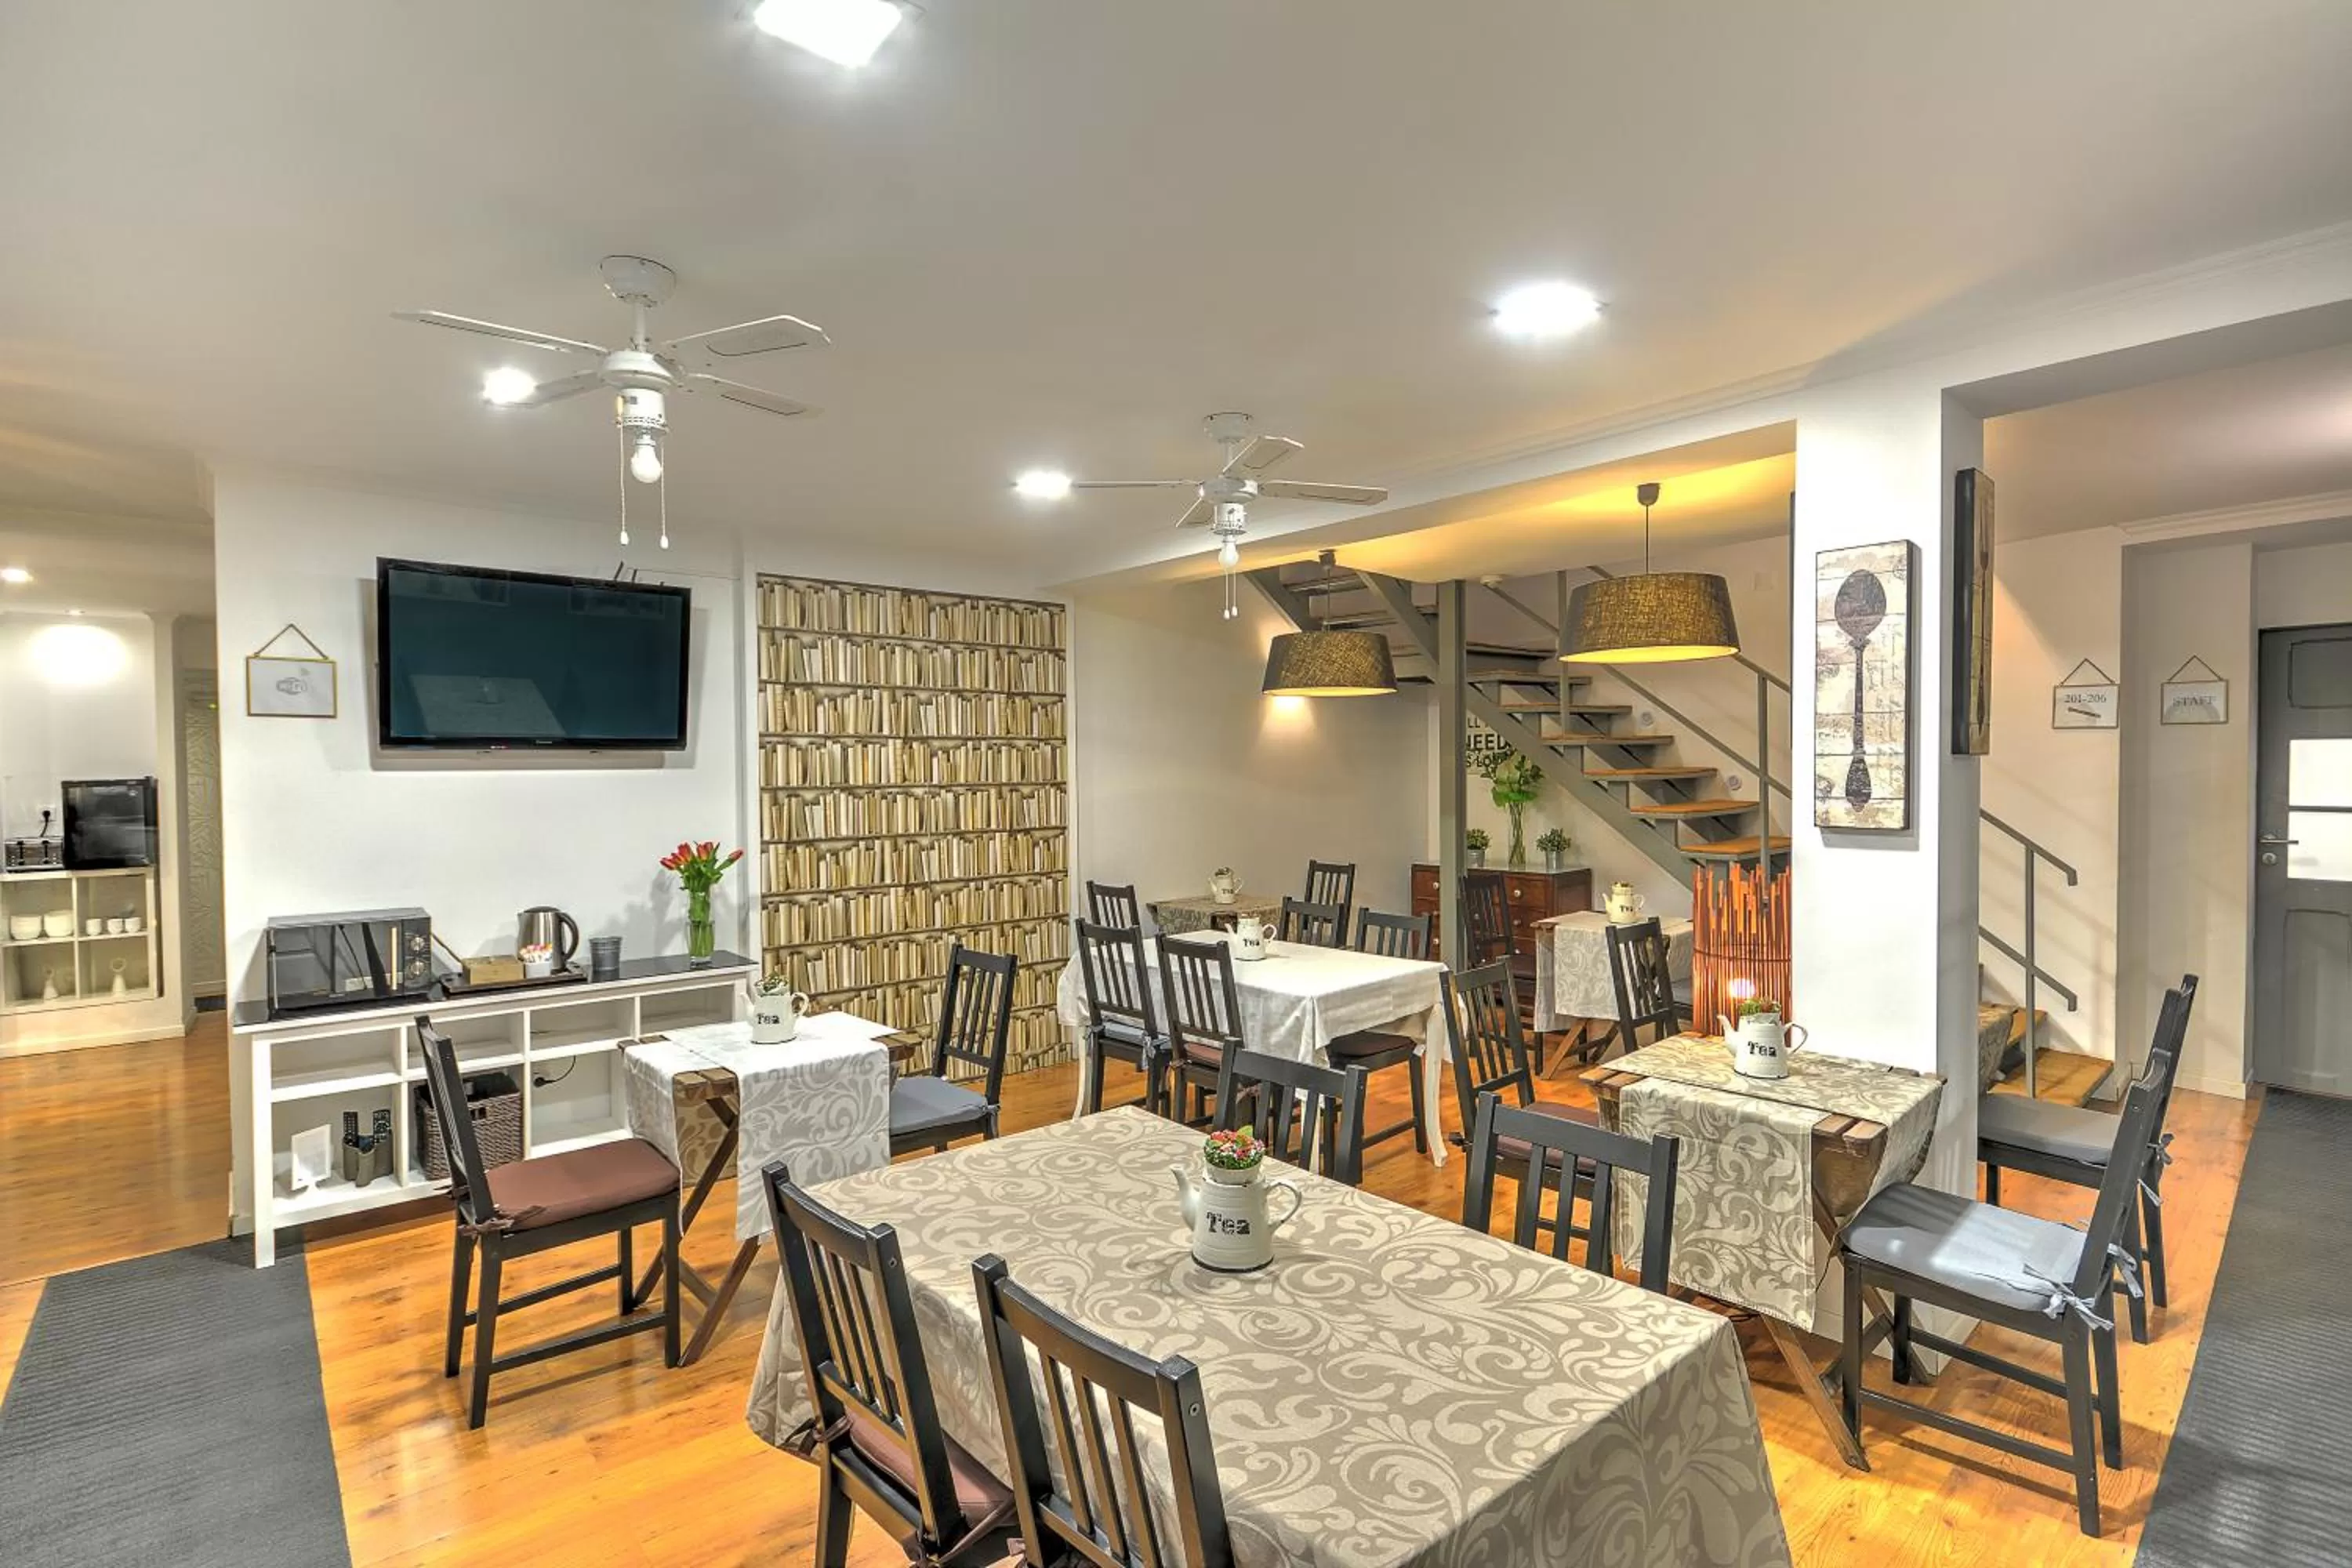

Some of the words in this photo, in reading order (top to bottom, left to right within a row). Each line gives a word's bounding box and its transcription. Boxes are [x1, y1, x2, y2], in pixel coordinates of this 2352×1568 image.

[757, 1012, 780, 1025] Tea
[1748, 1040, 1777, 1058] Tea
[1206, 1211, 1250, 1236] Tea
